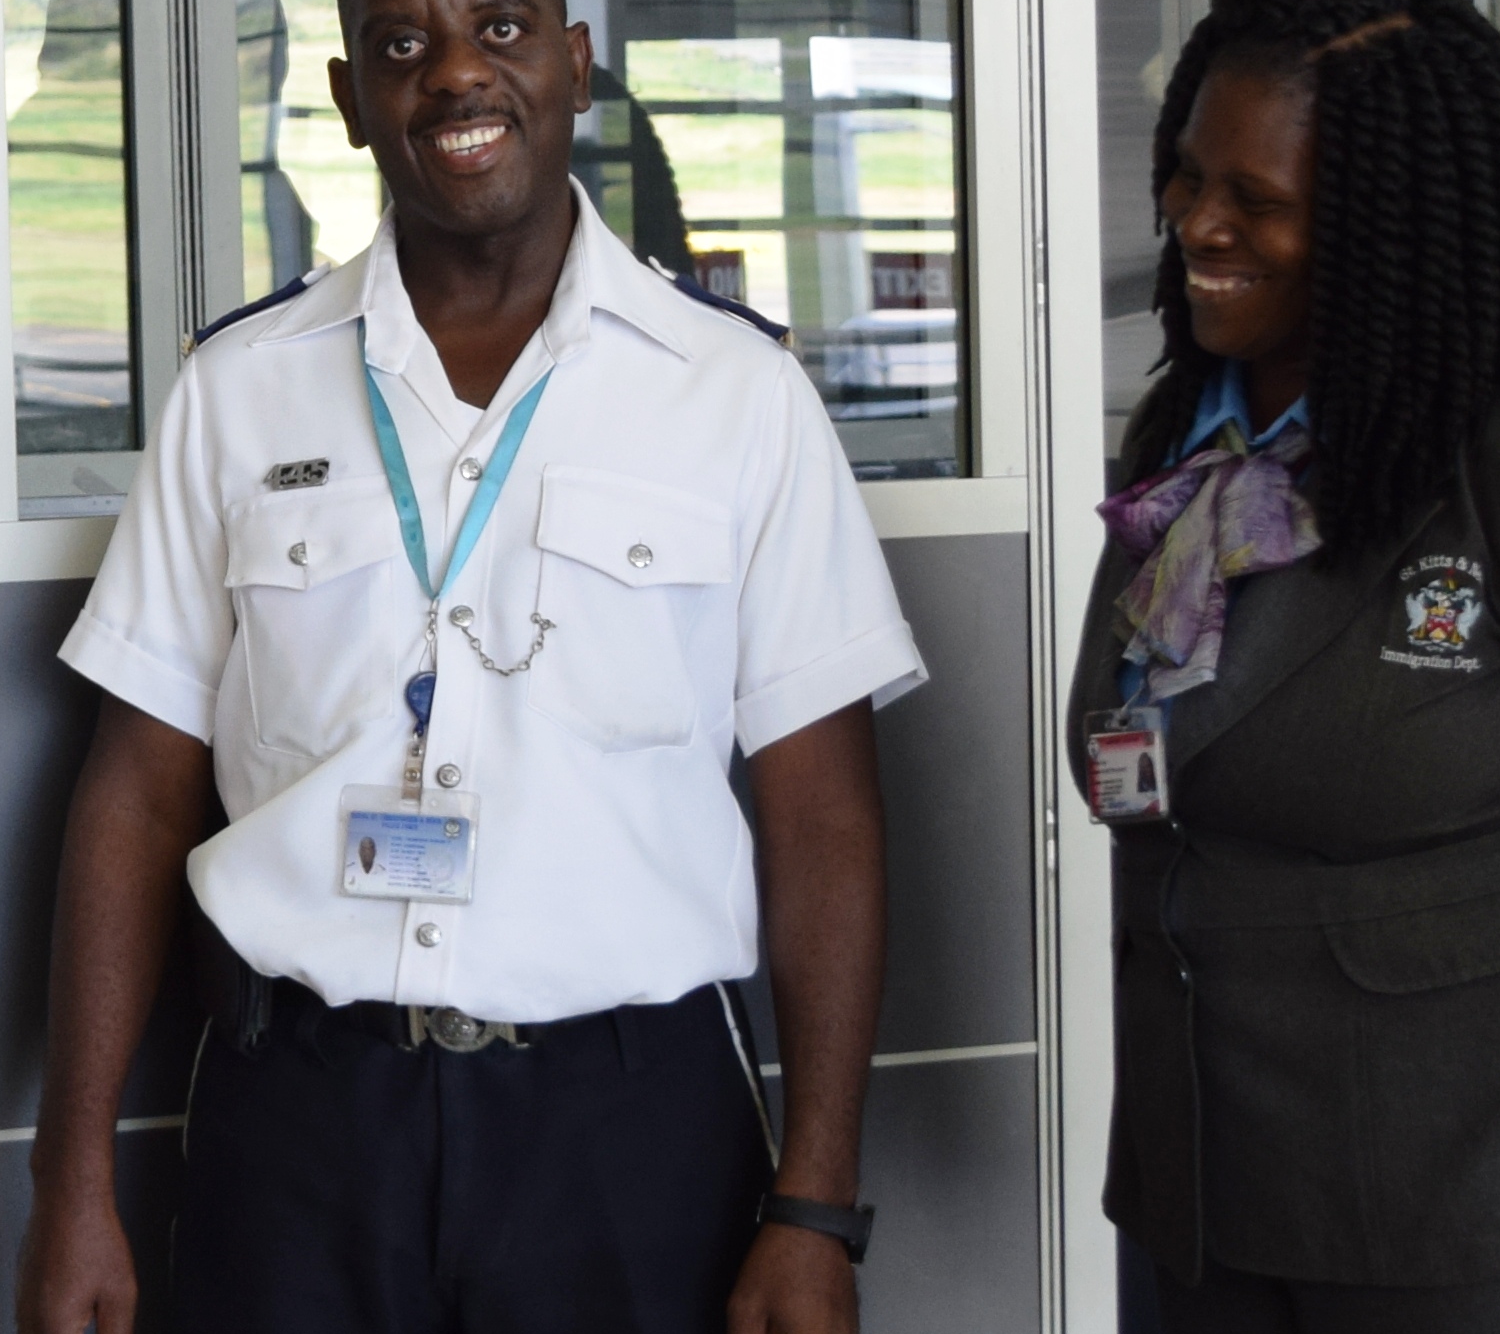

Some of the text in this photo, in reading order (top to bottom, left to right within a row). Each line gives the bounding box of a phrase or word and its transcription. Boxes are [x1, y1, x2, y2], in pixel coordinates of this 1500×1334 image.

[264, 458, 329, 491] 445
[1419, 554, 1454, 571] Kitts
[1379, 645, 1452, 669] Immigration
